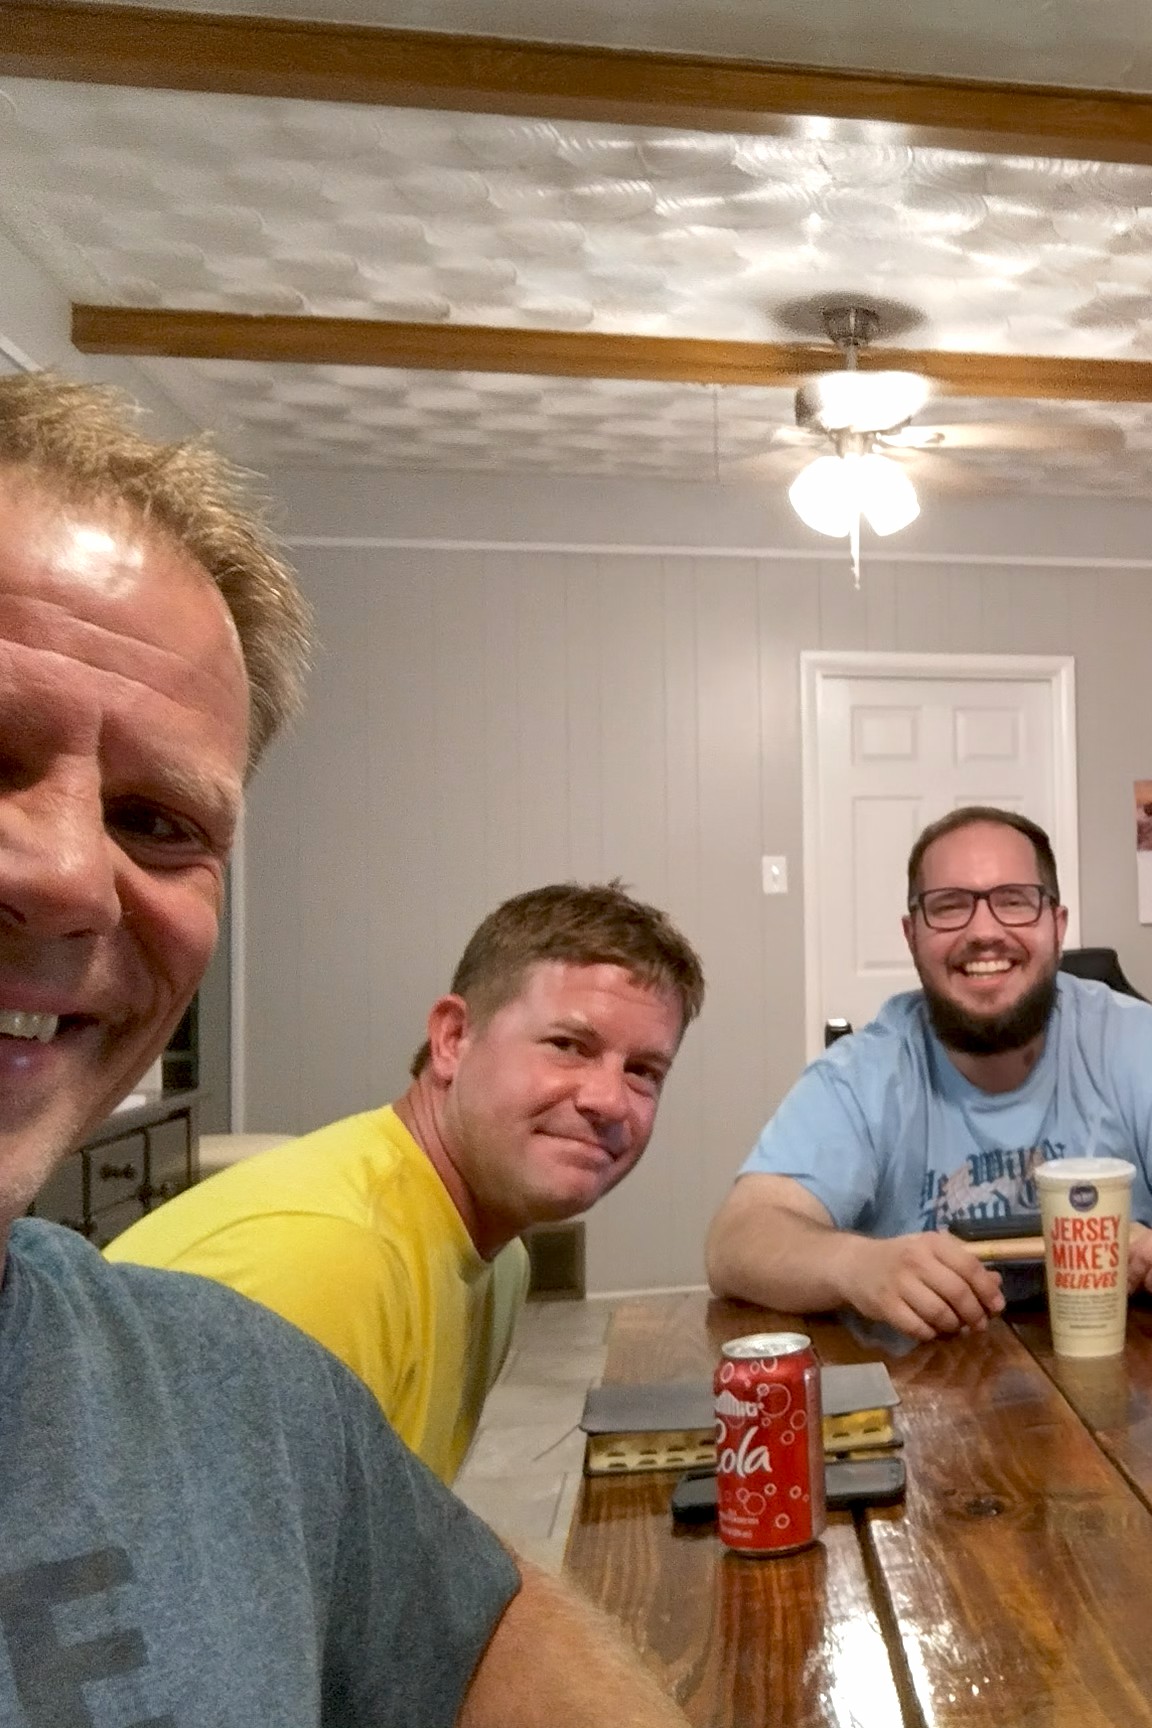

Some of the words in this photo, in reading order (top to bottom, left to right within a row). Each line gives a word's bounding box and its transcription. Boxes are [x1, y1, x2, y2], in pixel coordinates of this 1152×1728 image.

[1051, 1215, 1121, 1242] JERSEY
[1052, 1243, 1119, 1270] MIKE'S
[1054, 1271, 1118, 1289] BELIEVES
